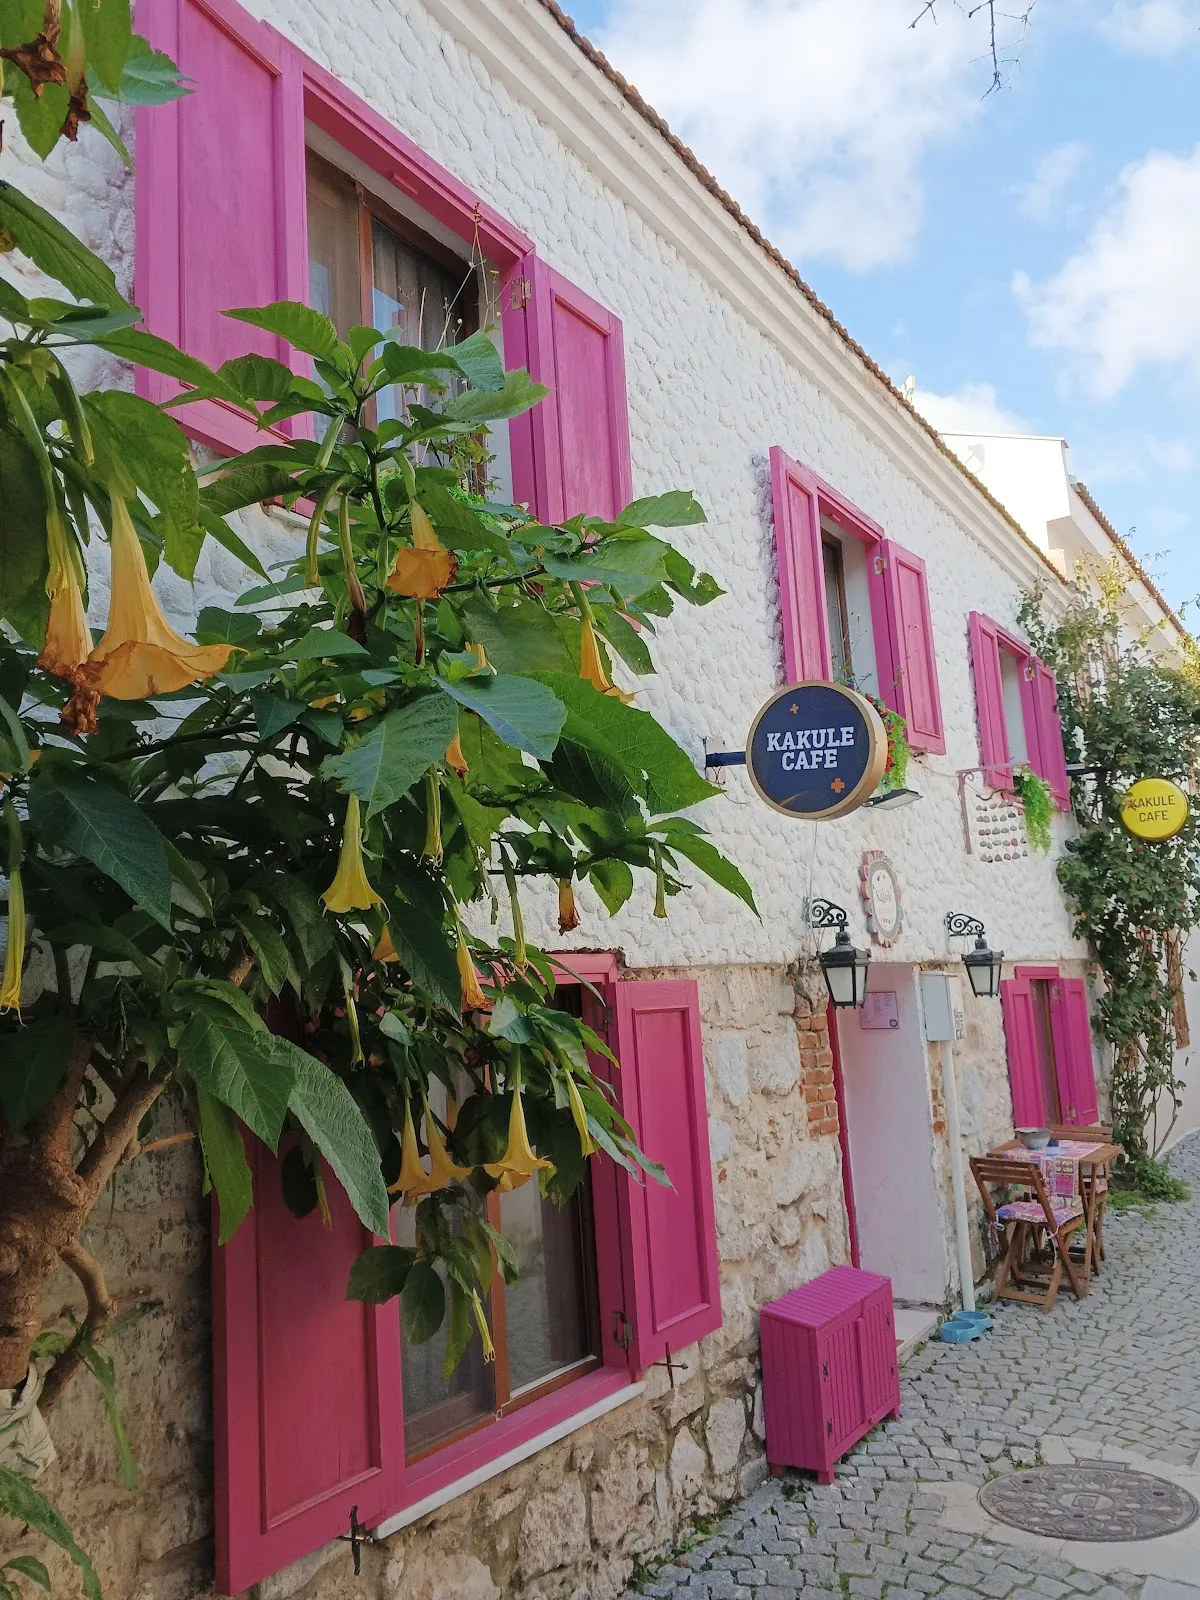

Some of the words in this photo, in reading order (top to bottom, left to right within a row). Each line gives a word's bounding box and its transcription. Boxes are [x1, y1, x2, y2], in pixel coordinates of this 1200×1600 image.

[766, 726, 855, 752] KAKULE
[781, 749, 838, 771] CAFE
[1129, 794, 1176, 810] KAKULE
[1139, 810, 1169, 823] CAFE
